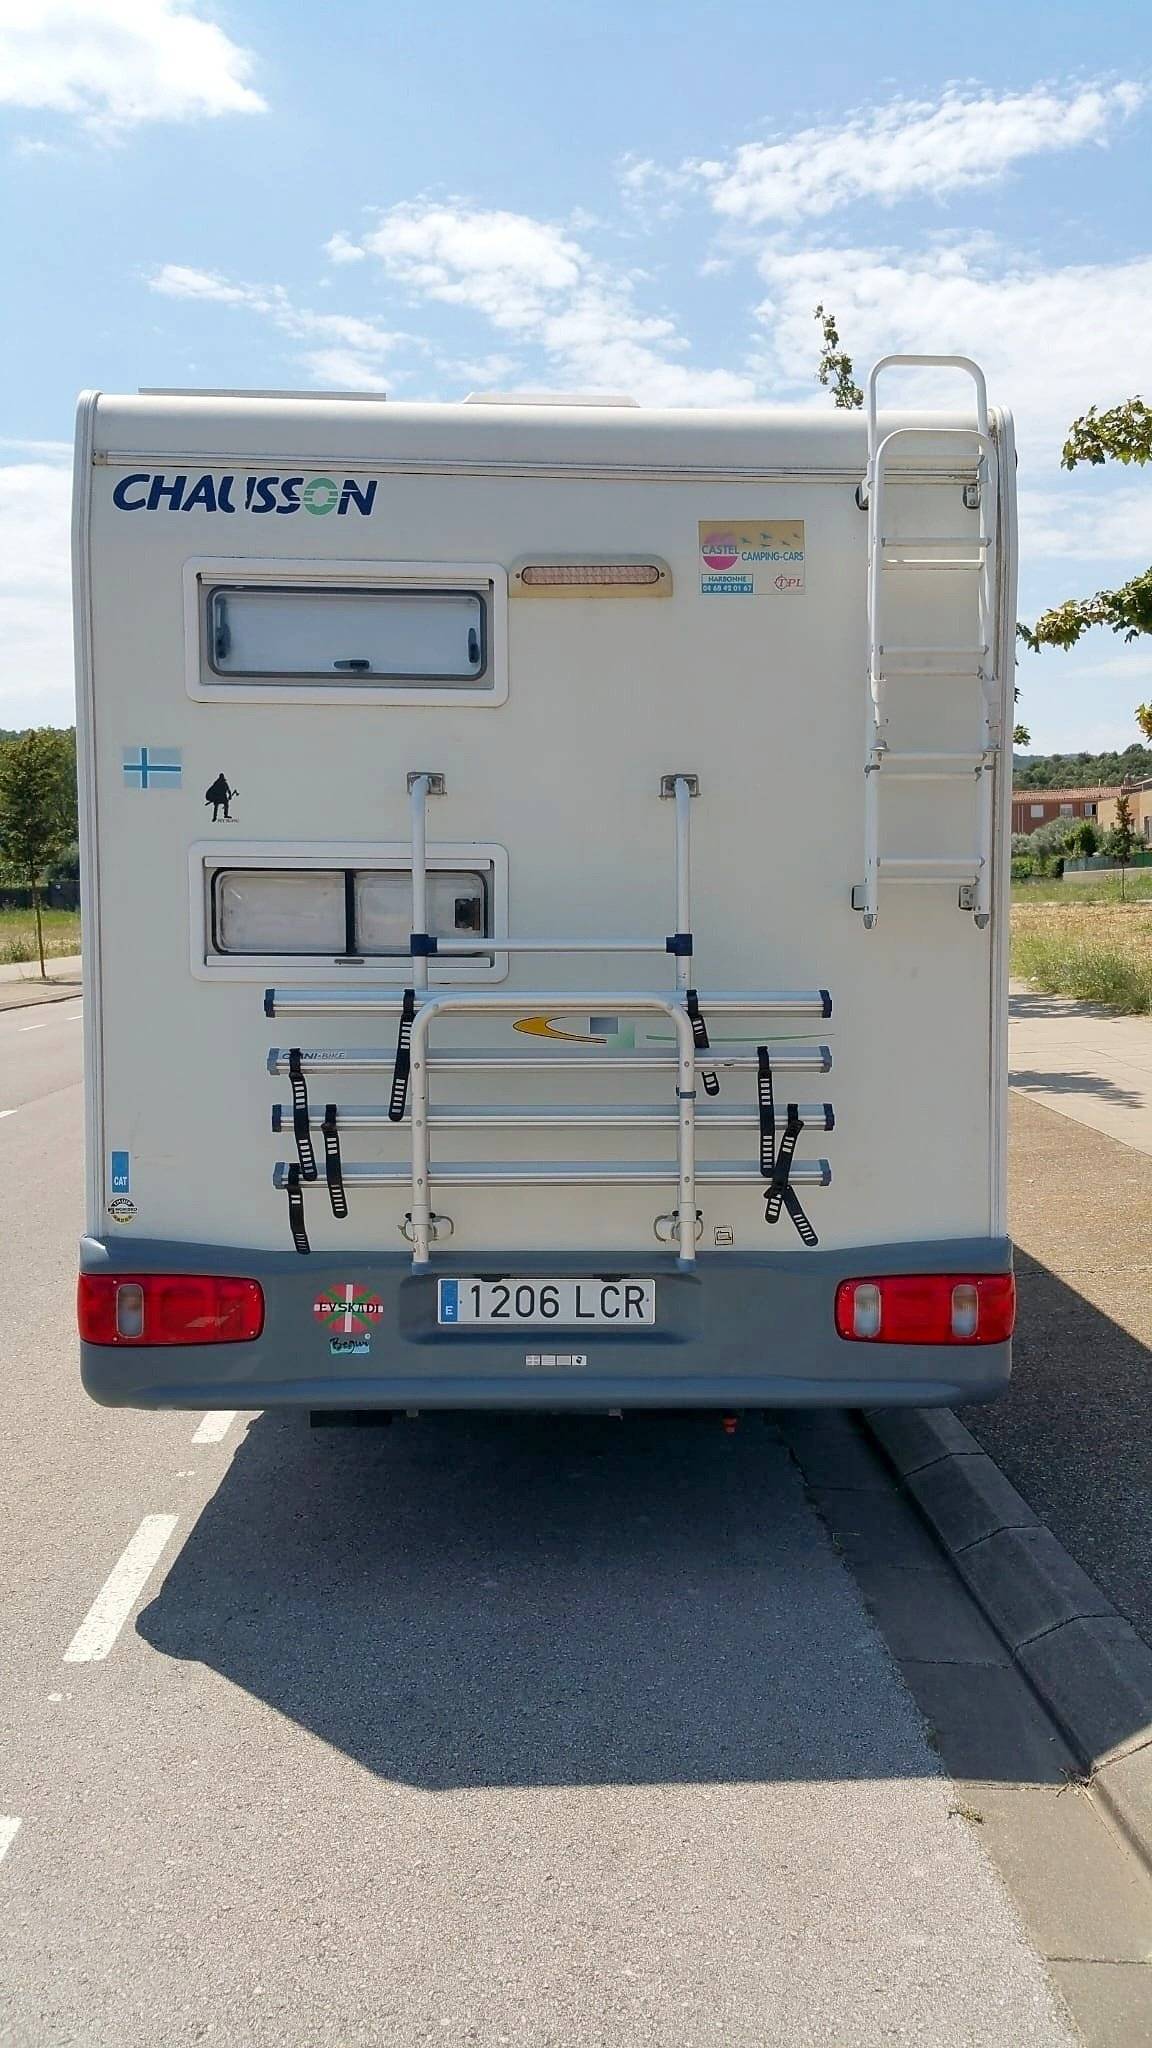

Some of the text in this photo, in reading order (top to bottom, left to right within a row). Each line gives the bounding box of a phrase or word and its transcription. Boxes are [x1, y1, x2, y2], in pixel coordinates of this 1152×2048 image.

[112, 473, 377, 516] CHAUSSON
[702, 544, 739, 555] CASTEL
[741, 551, 804, 561] CAMPING-CARS
[113, 1176, 128, 1186] CAT
[470, 1284, 645, 1319] 1206 LCR
[445, 1305, 454, 1316] E
